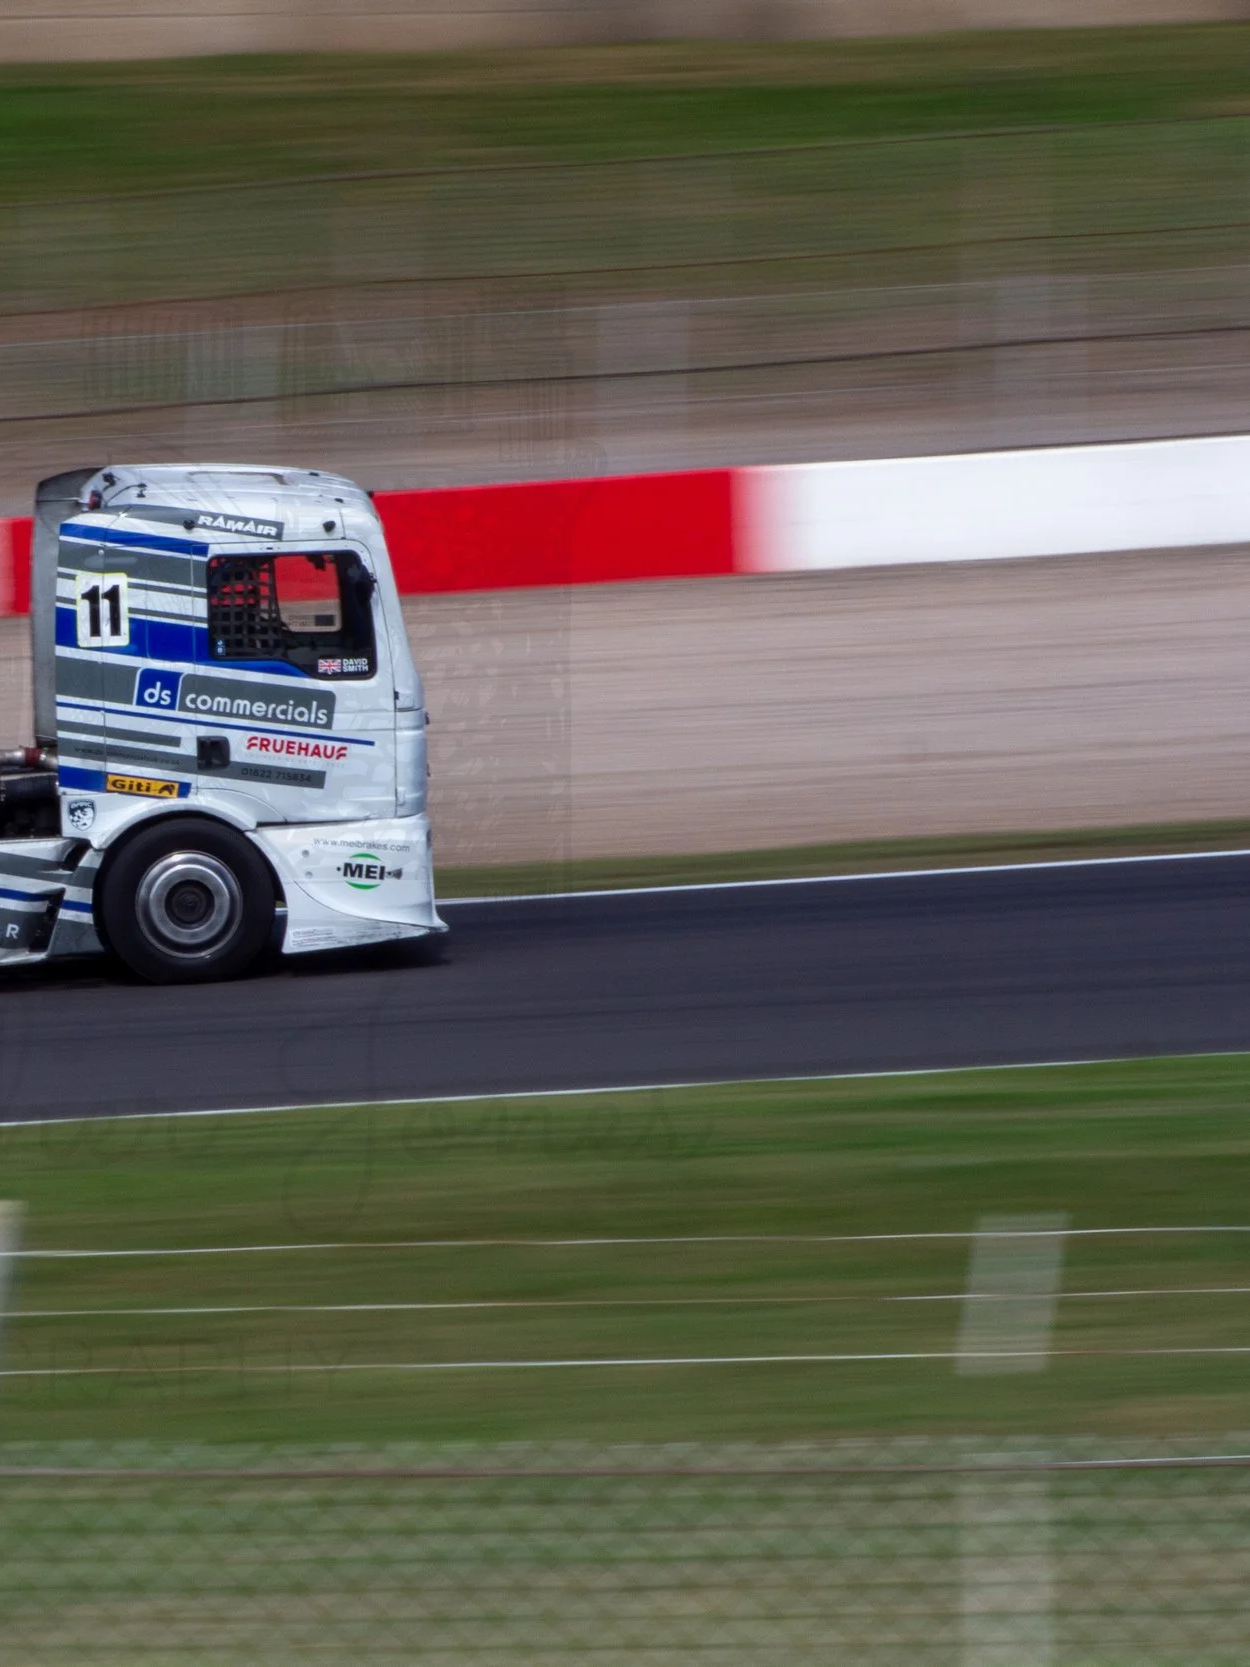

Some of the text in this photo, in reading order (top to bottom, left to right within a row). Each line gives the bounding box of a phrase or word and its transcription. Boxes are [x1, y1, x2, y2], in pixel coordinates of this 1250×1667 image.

[197, 514, 278, 537] RAMAIR
[81, 584, 122, 637] 11
[342, 658, 368, 667] DAVID
[342, 664, 369, 673] SMITH
[143, 681, 328, 725] ds commercials
[246, 736, 348, 760] FRUEHAUF
[111, 779, 151, 793] Giti
[342, 862, 387, 881] MEI
